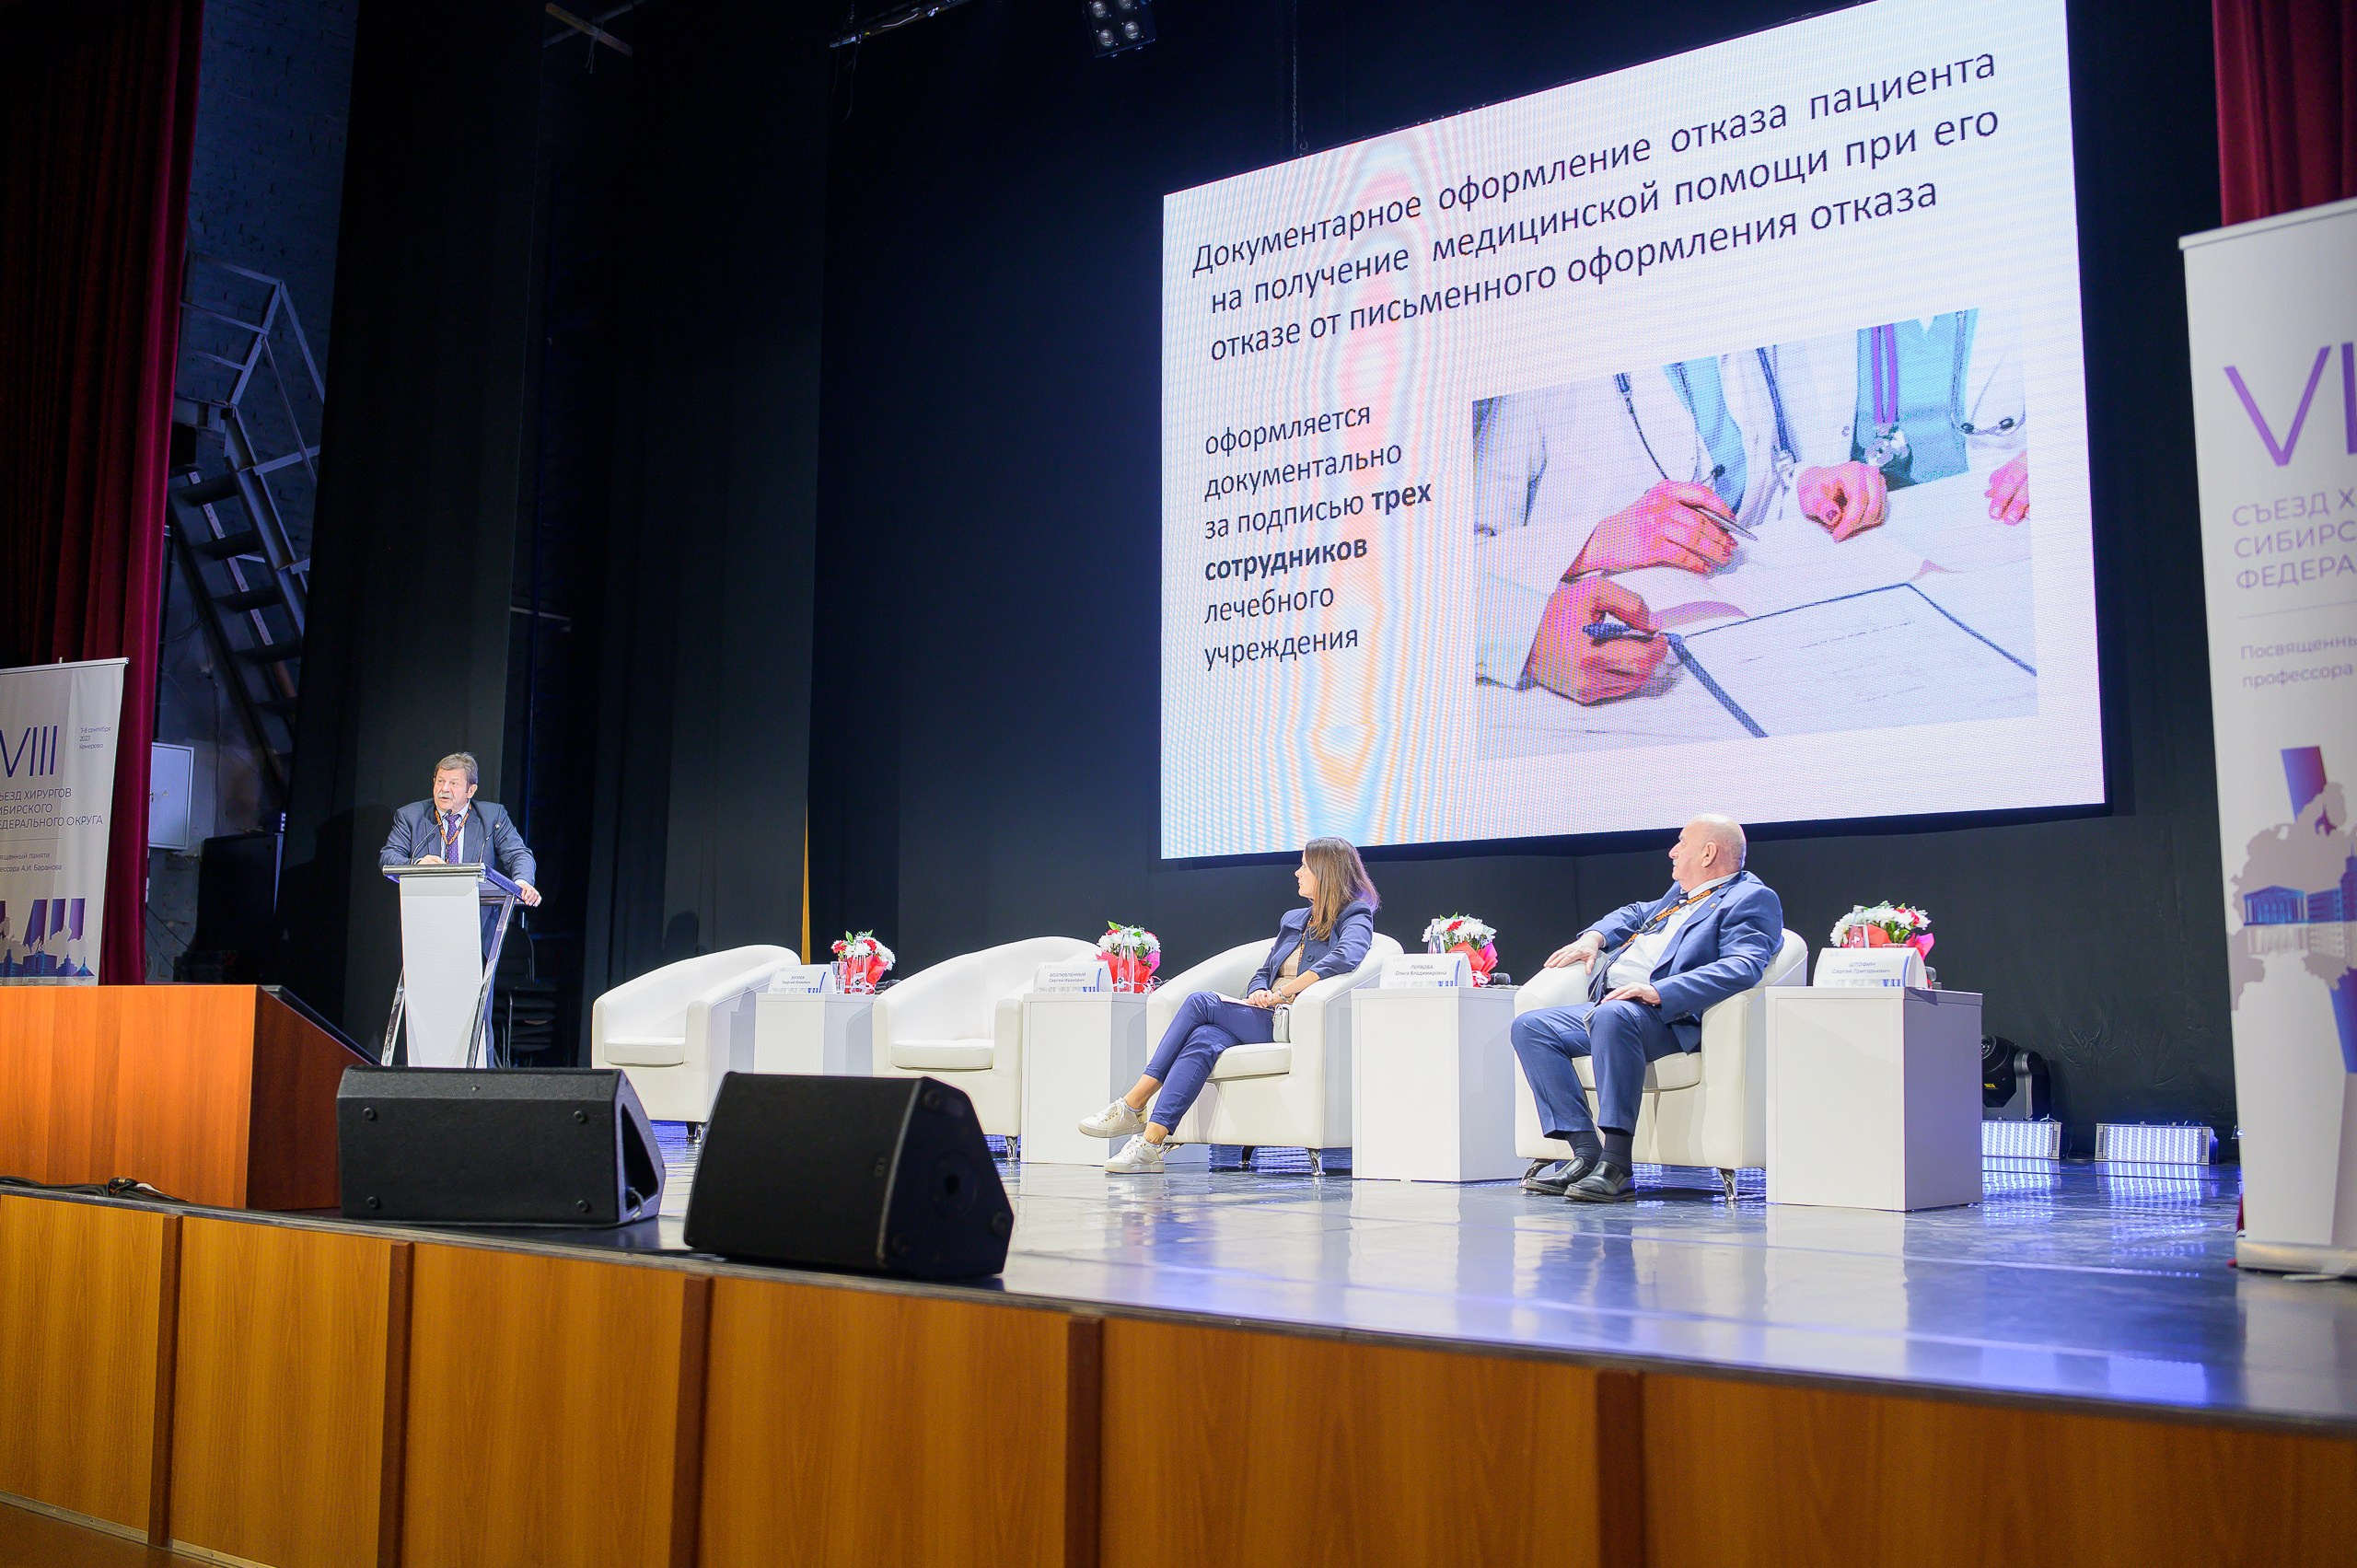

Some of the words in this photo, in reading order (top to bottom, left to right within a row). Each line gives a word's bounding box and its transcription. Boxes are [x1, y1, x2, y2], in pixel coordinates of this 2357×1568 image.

[1193, 197, 1421, 274] Документарное
[1439, 139, 1650, 211] оформление
[1672, 105, 1785, 152] отказа
[1811, 53, 1994, 119] пациента
[1213, 290, 1241, 313] на
[1256, 250, 1408, 303] получение
[1434, 180, 1657, 261] медицинской
[1677, 150, 1827, 204] помощи
[1847, 130, 1915, 169] при
[1935, 112, 1997, 145] его
[1212, 324, 1300, 360] отказе
[1311, 314, 1340, 338] от
[1351, 266, 1555, 330] письменного
[1568, 213, 1795, 285] оформления
[1811, 183, 1935, 229] отказа
[1206, 406, 1369, 457] оформляется
[1205, 444, 1401, 501] документально
[1206, 518, 1228, 539] за
[1239, 496, 1363, 534] подписью
[1372, 484, 1431, 515] трех
[2232, 492, 2330, 527] СЪЕЗД
[1205, 540, 1366, 580] сотрудников
[1204, 588, 1333, 623] лечебного
[1205, 630, 1357, 671] учреждения
[2242, 663, 2354, 689] профессора
[24, 787, 72, 800] ХИРУРГОВ
[66, 815, 103, 827] ОКРУГА
[34, 864, 63, 873] Баранова
